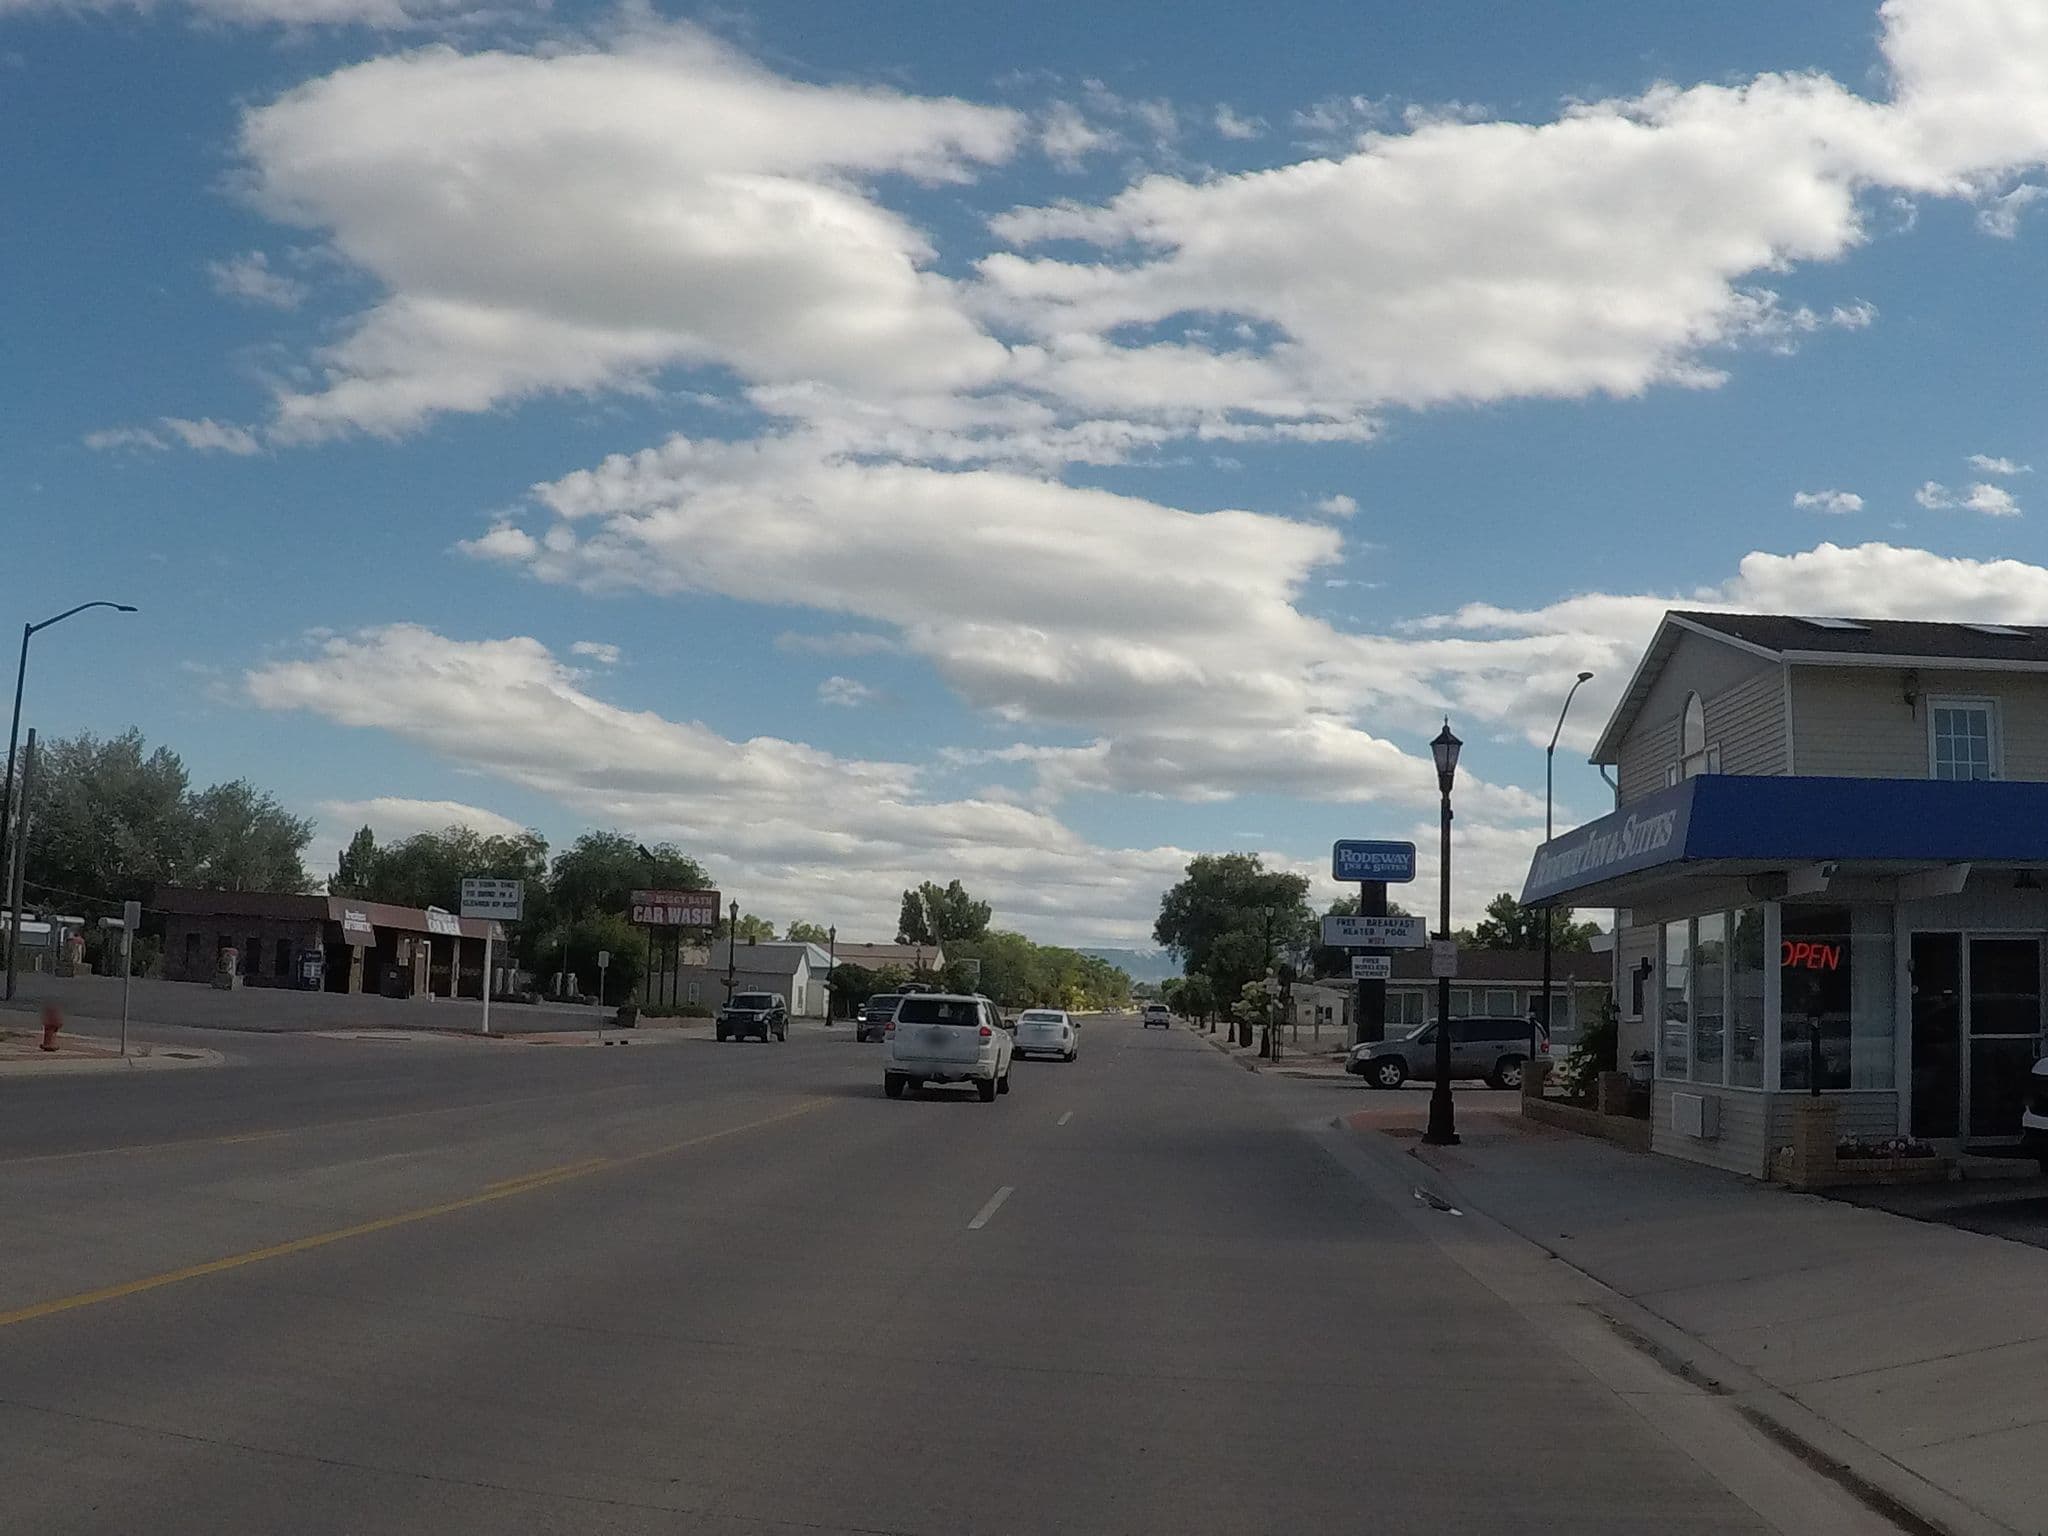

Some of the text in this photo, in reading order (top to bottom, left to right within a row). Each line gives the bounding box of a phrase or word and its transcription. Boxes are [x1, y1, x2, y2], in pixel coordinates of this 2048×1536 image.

[1617, 809, 1678, 860] SUITES
[1339, 849, 1411, 864] RODEWAY
[1372, 863, 1408, 872] SUITES
[632, 905, 712, 925] CAR WASH
[1336, 918, 1414, 928] FREE BREAKFAST
[1385, 928, 1408, 937] POOL
[1781, 941, 1840, 970] OPEN
